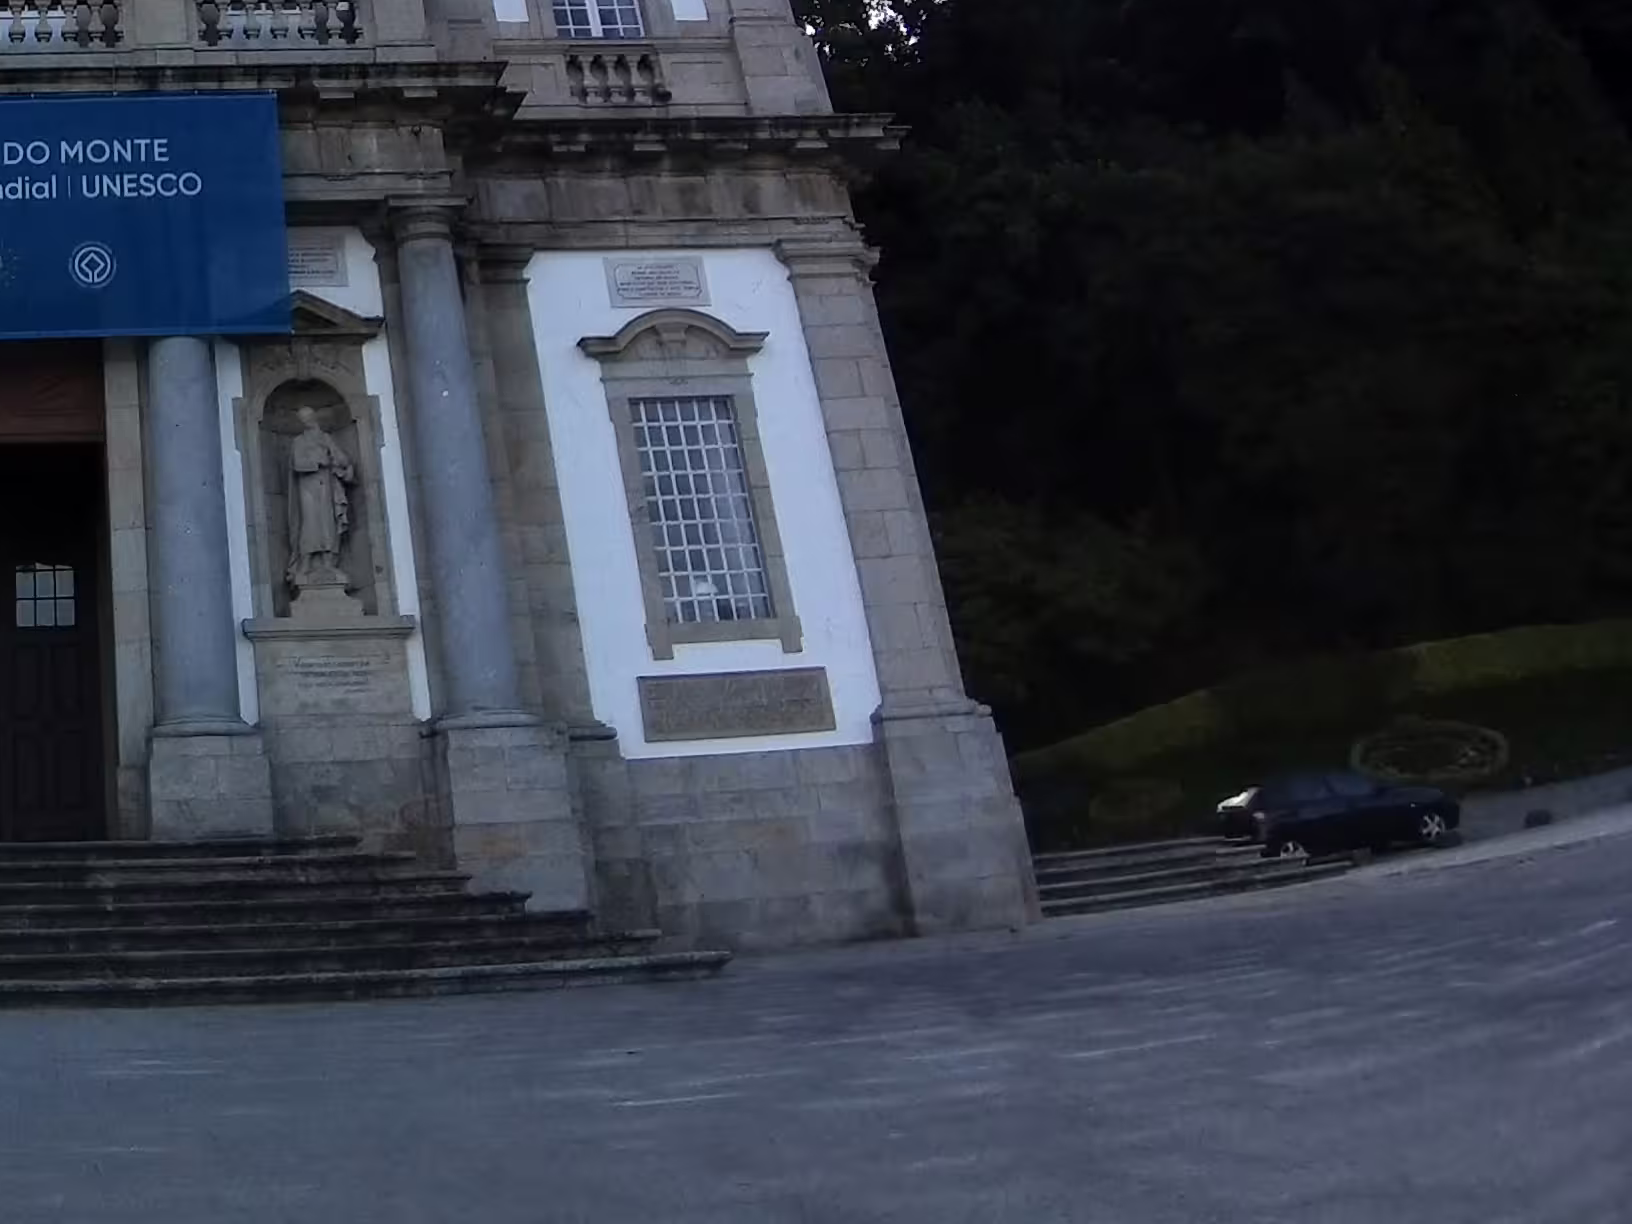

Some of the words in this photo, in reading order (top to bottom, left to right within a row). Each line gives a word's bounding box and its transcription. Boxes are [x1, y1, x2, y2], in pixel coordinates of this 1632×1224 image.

[3, 140, 50, 165] DO
[60, 138, 170, 164] MONTE
[82, 172, 202, 198] UNESCO
